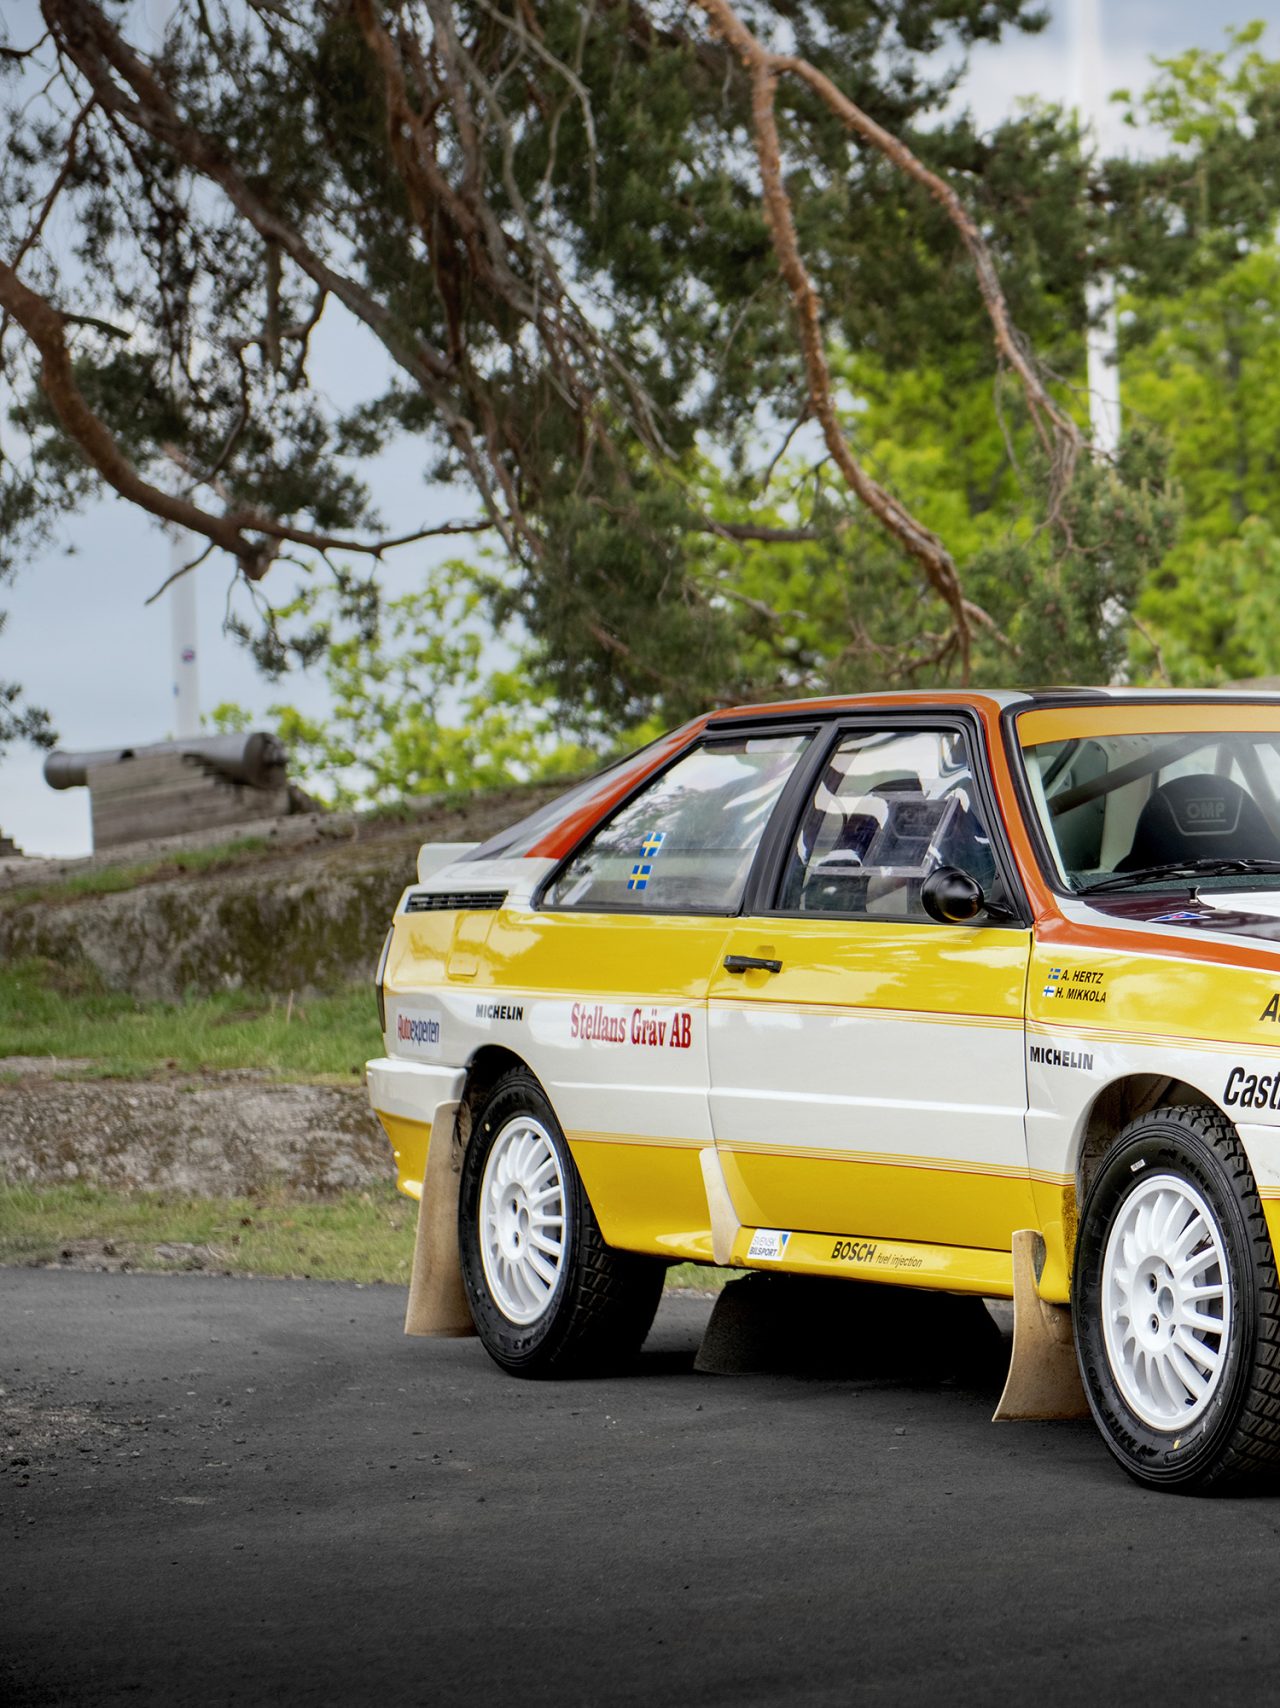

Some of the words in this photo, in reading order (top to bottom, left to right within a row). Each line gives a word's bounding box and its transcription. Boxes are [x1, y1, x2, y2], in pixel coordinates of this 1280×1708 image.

[1186, 801, 1225, 819] OMP
[1061, 969, 1070, 981] A.
[1072, 970, 1103, 984] HERTZ
[1055, 987, 1064, 998] H.
[1066, 988, 1107, 1003] MIKKOLA
[475, 1003, 524, 1021] MICHELIN
[397, 1014, 440, 1046] Autoexperten
[570, 1002, 626, 1043] Stellans
[631, 1008, 667, 1047] Gräv
[669, 1012, 692, 1048] AB
[1029, 1046, 1093, 1070] MICHELIN
[749, 1246, 777, 1257] BILSPORT
[831, 1241, 877, 1262] BOSCH
[876, 1253, 891, 1264] fuel
[891, 1254, 923, 1268] injection
